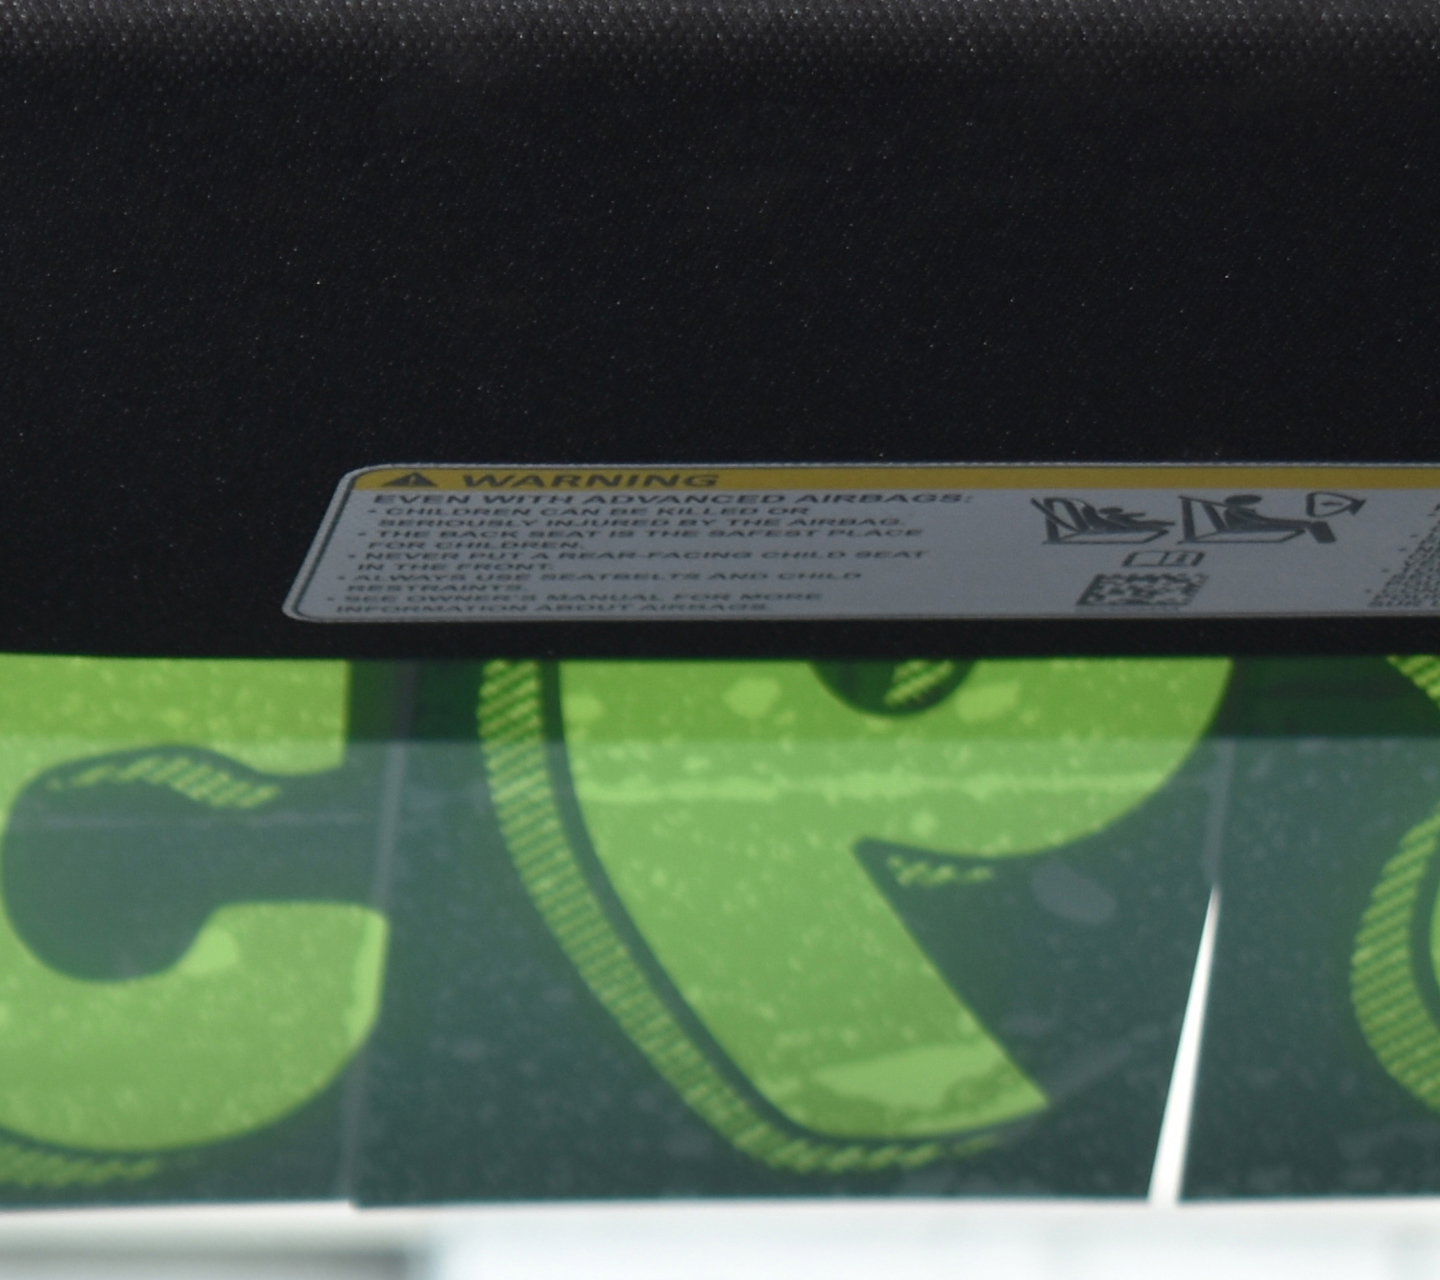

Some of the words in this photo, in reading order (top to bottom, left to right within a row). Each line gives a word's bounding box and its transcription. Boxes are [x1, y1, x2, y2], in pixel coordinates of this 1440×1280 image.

[461, 474, 720, 488] WARNING
[373, 494, 470, 505] EVEN
[482, 494, 574, 505] WITH
[581, 494, 786, 504] ADVANCED
[793, 493, 973, 504] AIRBAGS:
[385, 508, 532, 516] CHILDREN
[539, 507, 601, 516] CAN
[609, 507, 648, 516] BE
[656, 507, 758, 516] KILLED
[768, 507, 810, 516] OR
[378, 519, 535, 528] SERIOUSLY
[545, 518, 670, 527] INJURED
[678, 518, 715, 527] BY
[729, 518, 781, 527] THE
[787, 518, 904, 527] AIRBAG.
[378, 530, 431, 539] THE
[439, 530, 519, 539] BACK
[528, 530, 602, 538] SEAT
[609, 530, 635, 538] IS
[646, 529, 700, 538] THE
[708, 529, 820, 538] SAFEST
[828, 529, 924, 538] PLACE
[368, 541, 426, 549] FOR
[434, 541, 583, 549] CHILDREN.
[364, 552, 459, 560] NEVER
[469, 552, 521, 560] PUT
[530, 552, 549, 560] A
[558, 551, 753, 560] REAR-FACING
[760, 550, 846, 559] CHILD
[855, 550, 928, 559] SEAT
[357, 563, 385, 571] IN
[396, 563, 447, 571] THE
[353, 574, 467, 582] ALWAYS
[476, 573, 531, 581] USE
[540, 573, 700, 581] SEATBELTS
[707, 572, 769, 580] AND
[777, 572, 862, 580] CHILD
[344, 594, 397, 602] SEE
[546, 594, 663, 602] MANUAL
[673, 593, 731, 601] FOR
[740, 593, 823, 601] MORE
[336, 604, 528, 613] INFORMATION
[535, 604, 633, 612] ABOUT
